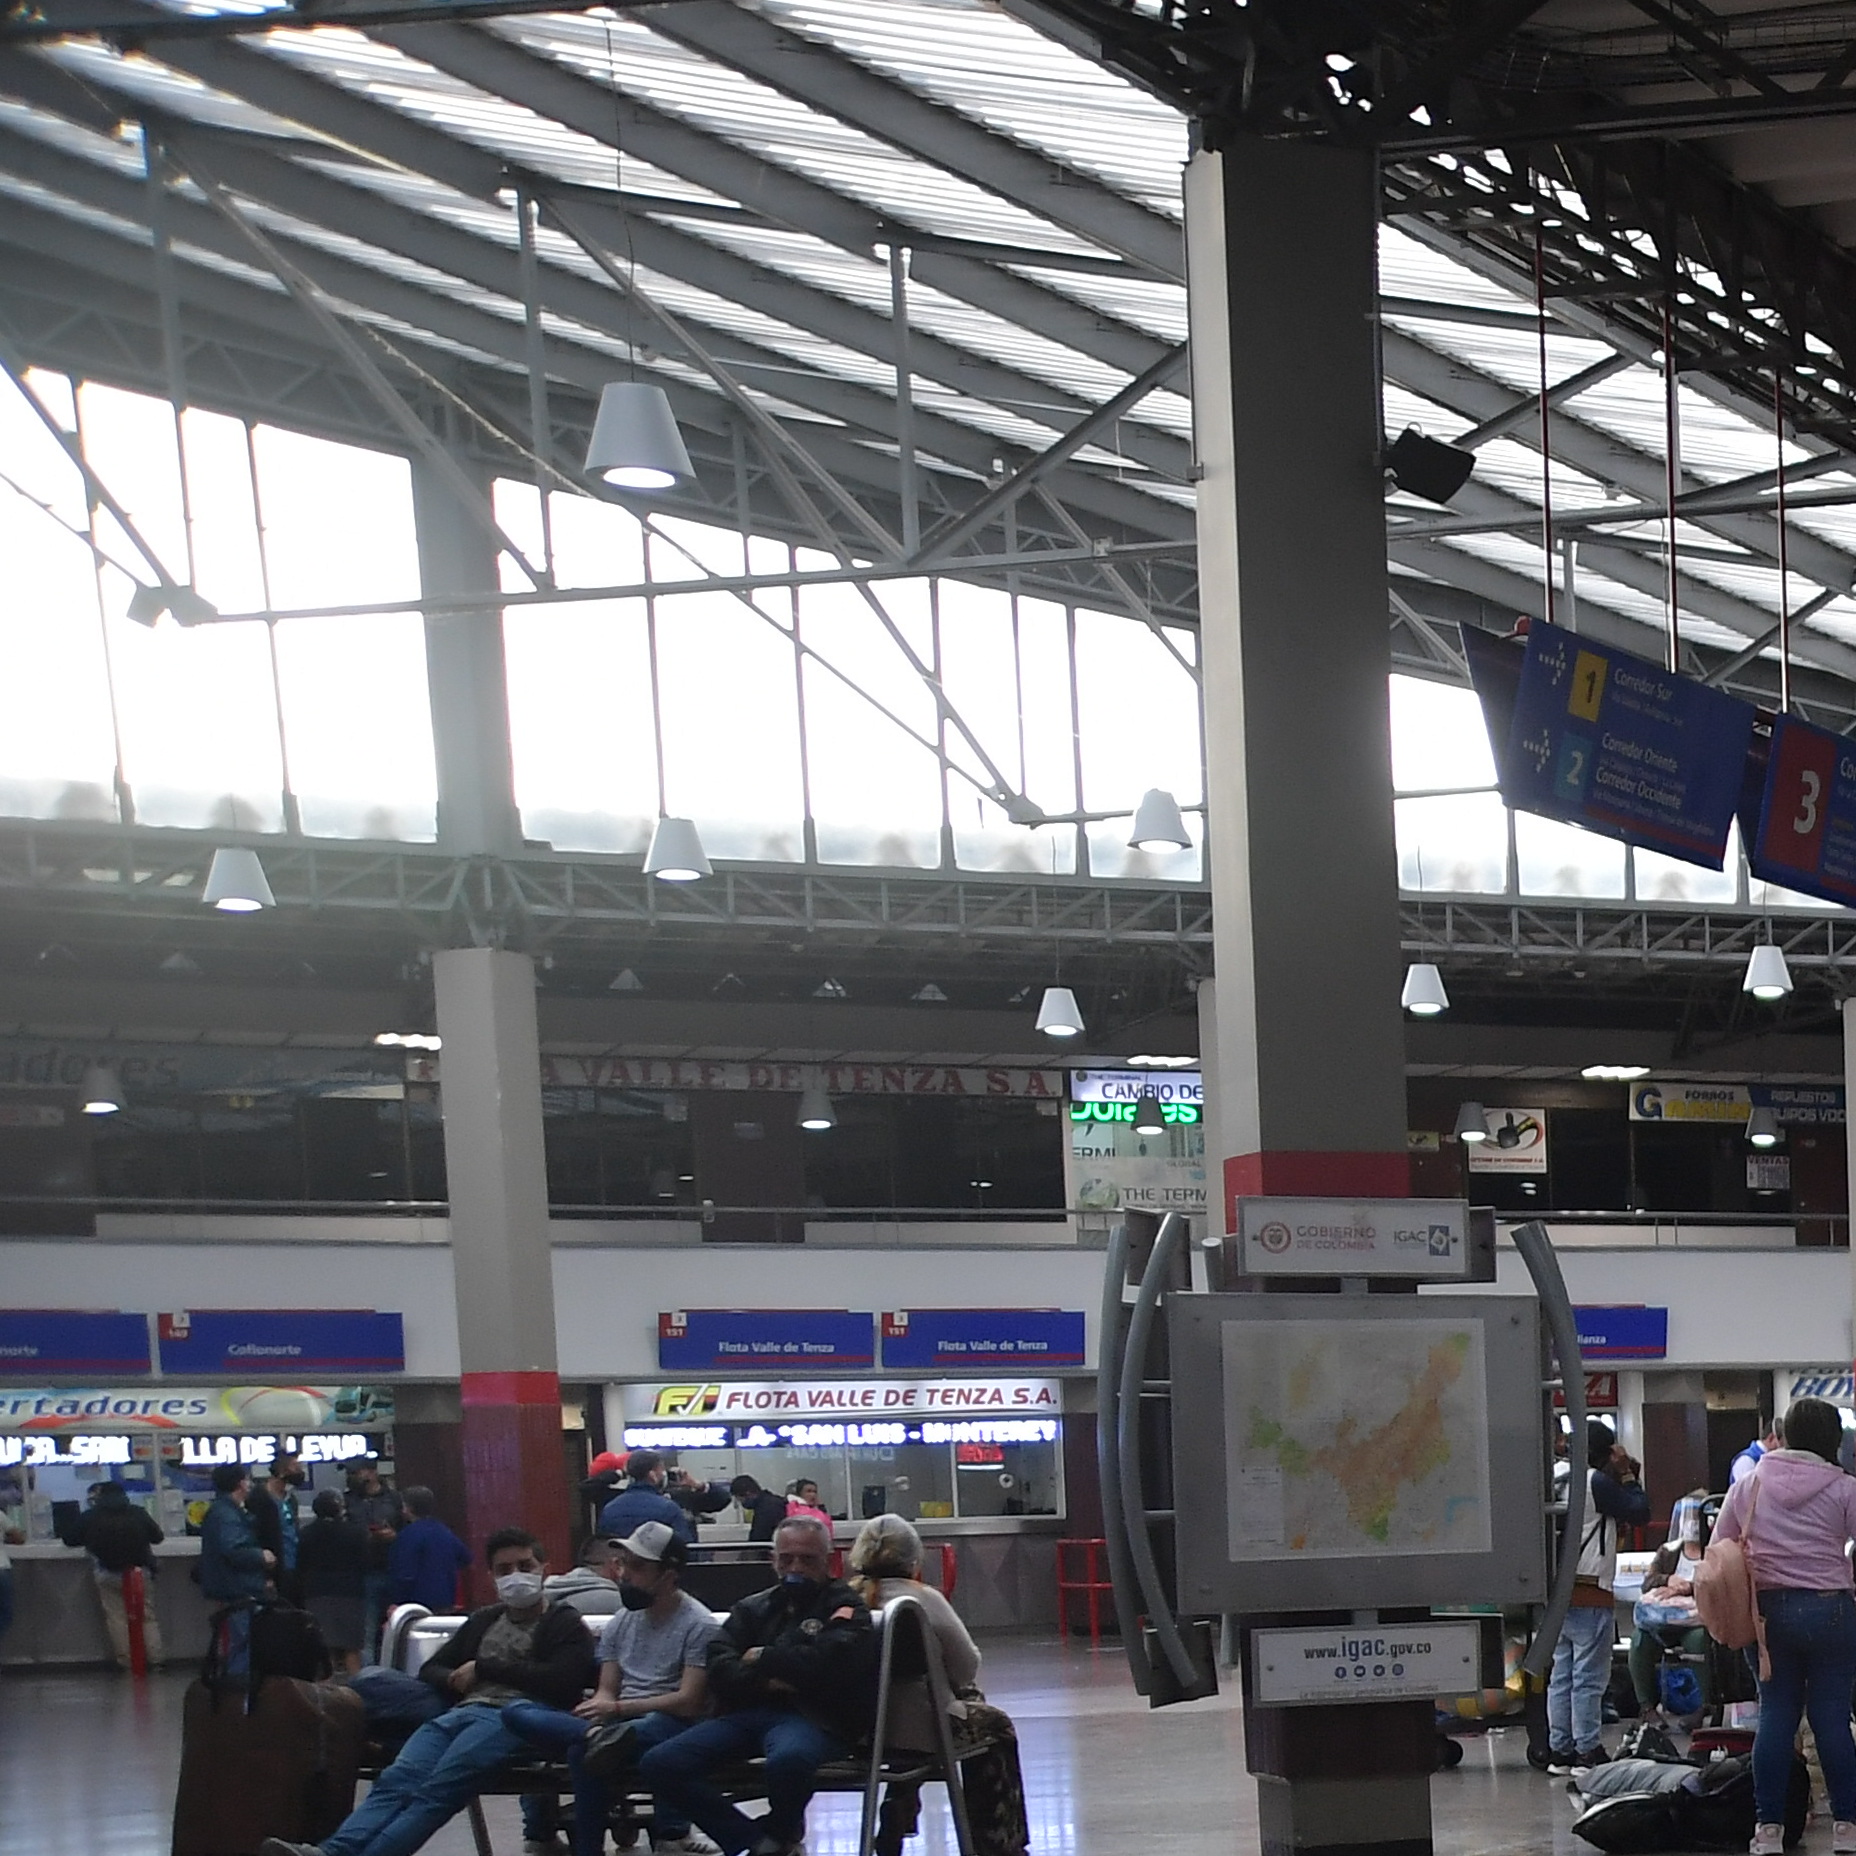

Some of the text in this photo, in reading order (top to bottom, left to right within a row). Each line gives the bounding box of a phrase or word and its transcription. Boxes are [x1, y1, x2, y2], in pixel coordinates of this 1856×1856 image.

[1585, 669, 1597, 704] 1
[1613, 667, 1674, 702] Corredor Sur
[1566, 750, 1584, 785] 2
[1793, 769, 1821, 834] 3
[821, 1064, 969, 1096] TENZA
[1296, 1225, 1377, 1238] GOBIERNO
[1392, 1230, 1427, 1243] IGAC
[1314, 1240, 1376, 1250] COLOMBIA
[718, 1341, 835, 1352] Flota Valle de Tenza
[937, 1339, 1048, 1352] Flota Valle de Tenza
[725, 1386, 1058, 1409] FLOTA VALLE DE TENZA S.A.
[1303, 1636, 1432, 1662] www.igac.gov.co
